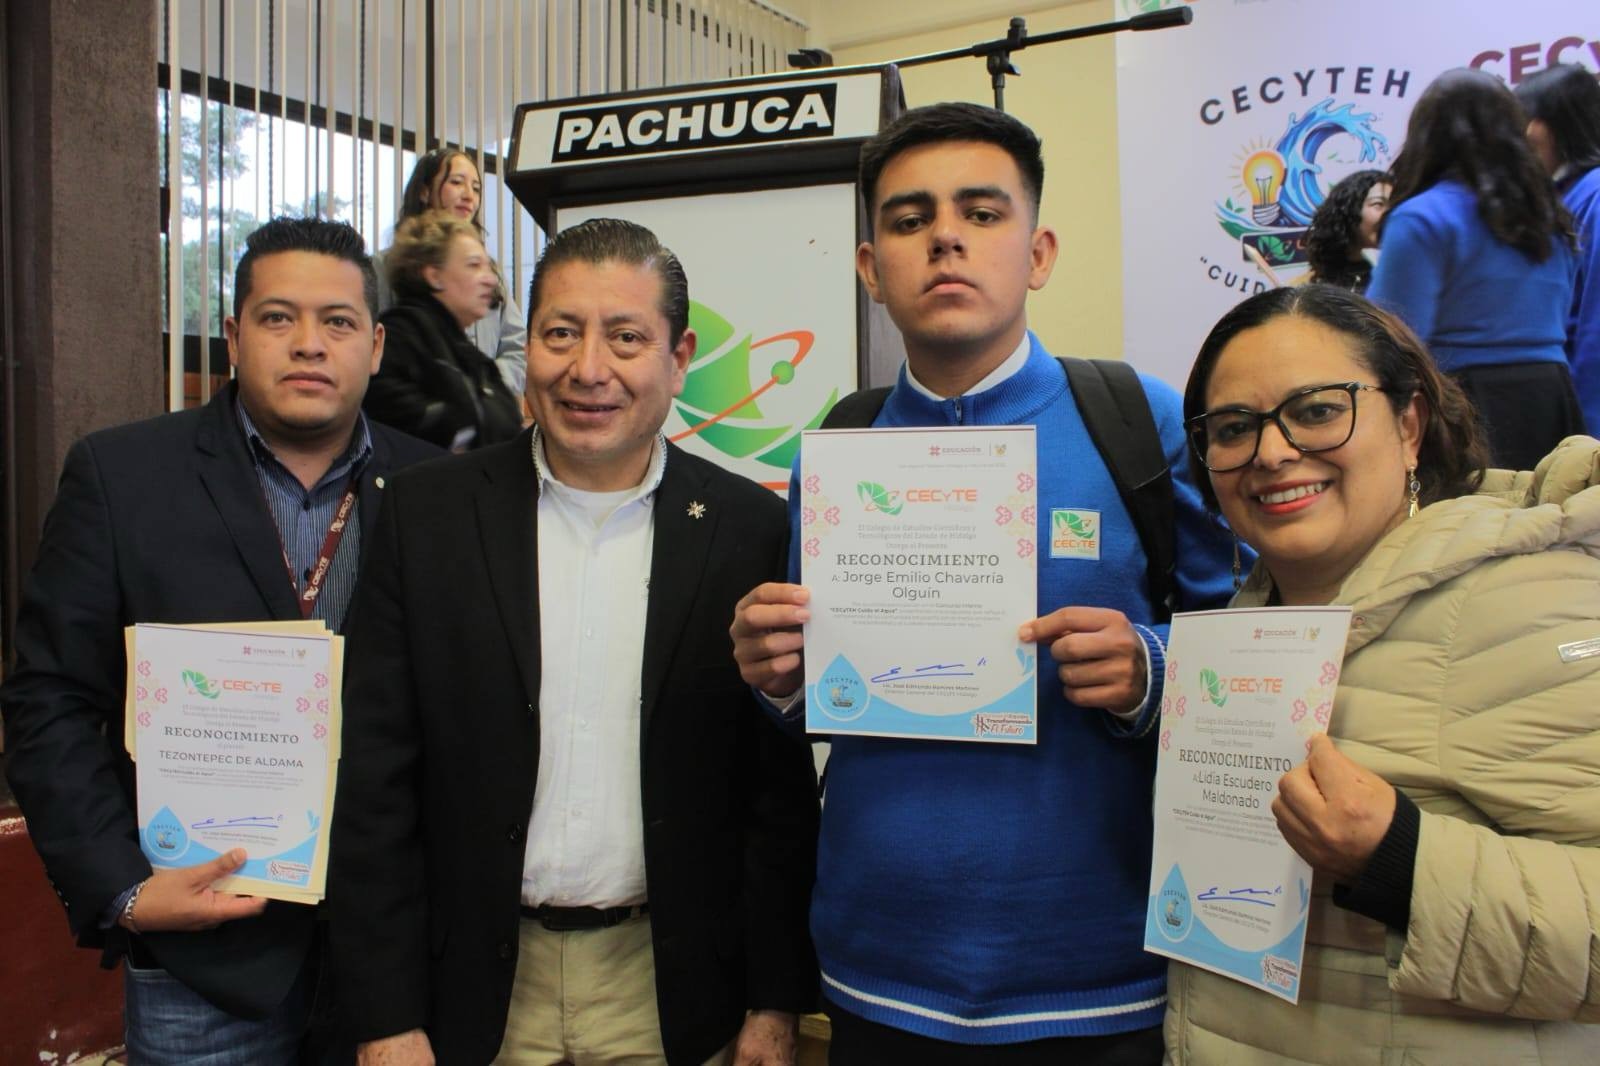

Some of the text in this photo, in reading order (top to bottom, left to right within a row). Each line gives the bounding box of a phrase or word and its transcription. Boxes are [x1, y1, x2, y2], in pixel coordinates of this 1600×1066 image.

[1200, 67, 1410, 125] CECYTEH
[558, 93, 832, 154] PACHUCA
[837, 554, 1000, 566] RECONOCIMIENTO
[842, 571, 882, 585] Jorge
[886, 572, 931, 583] Emilio
[164, 726, 299, 744] RECONOCIMIENTO
[160, 750, 304, 769] TEZONTEPEC DE ALDAMA
[1179, 749, 1292, 772] RECONOCIMIENTO
[1223, 773, 1272, 792] Escudero
[1202, 789, 1259, 809] Maldonado
